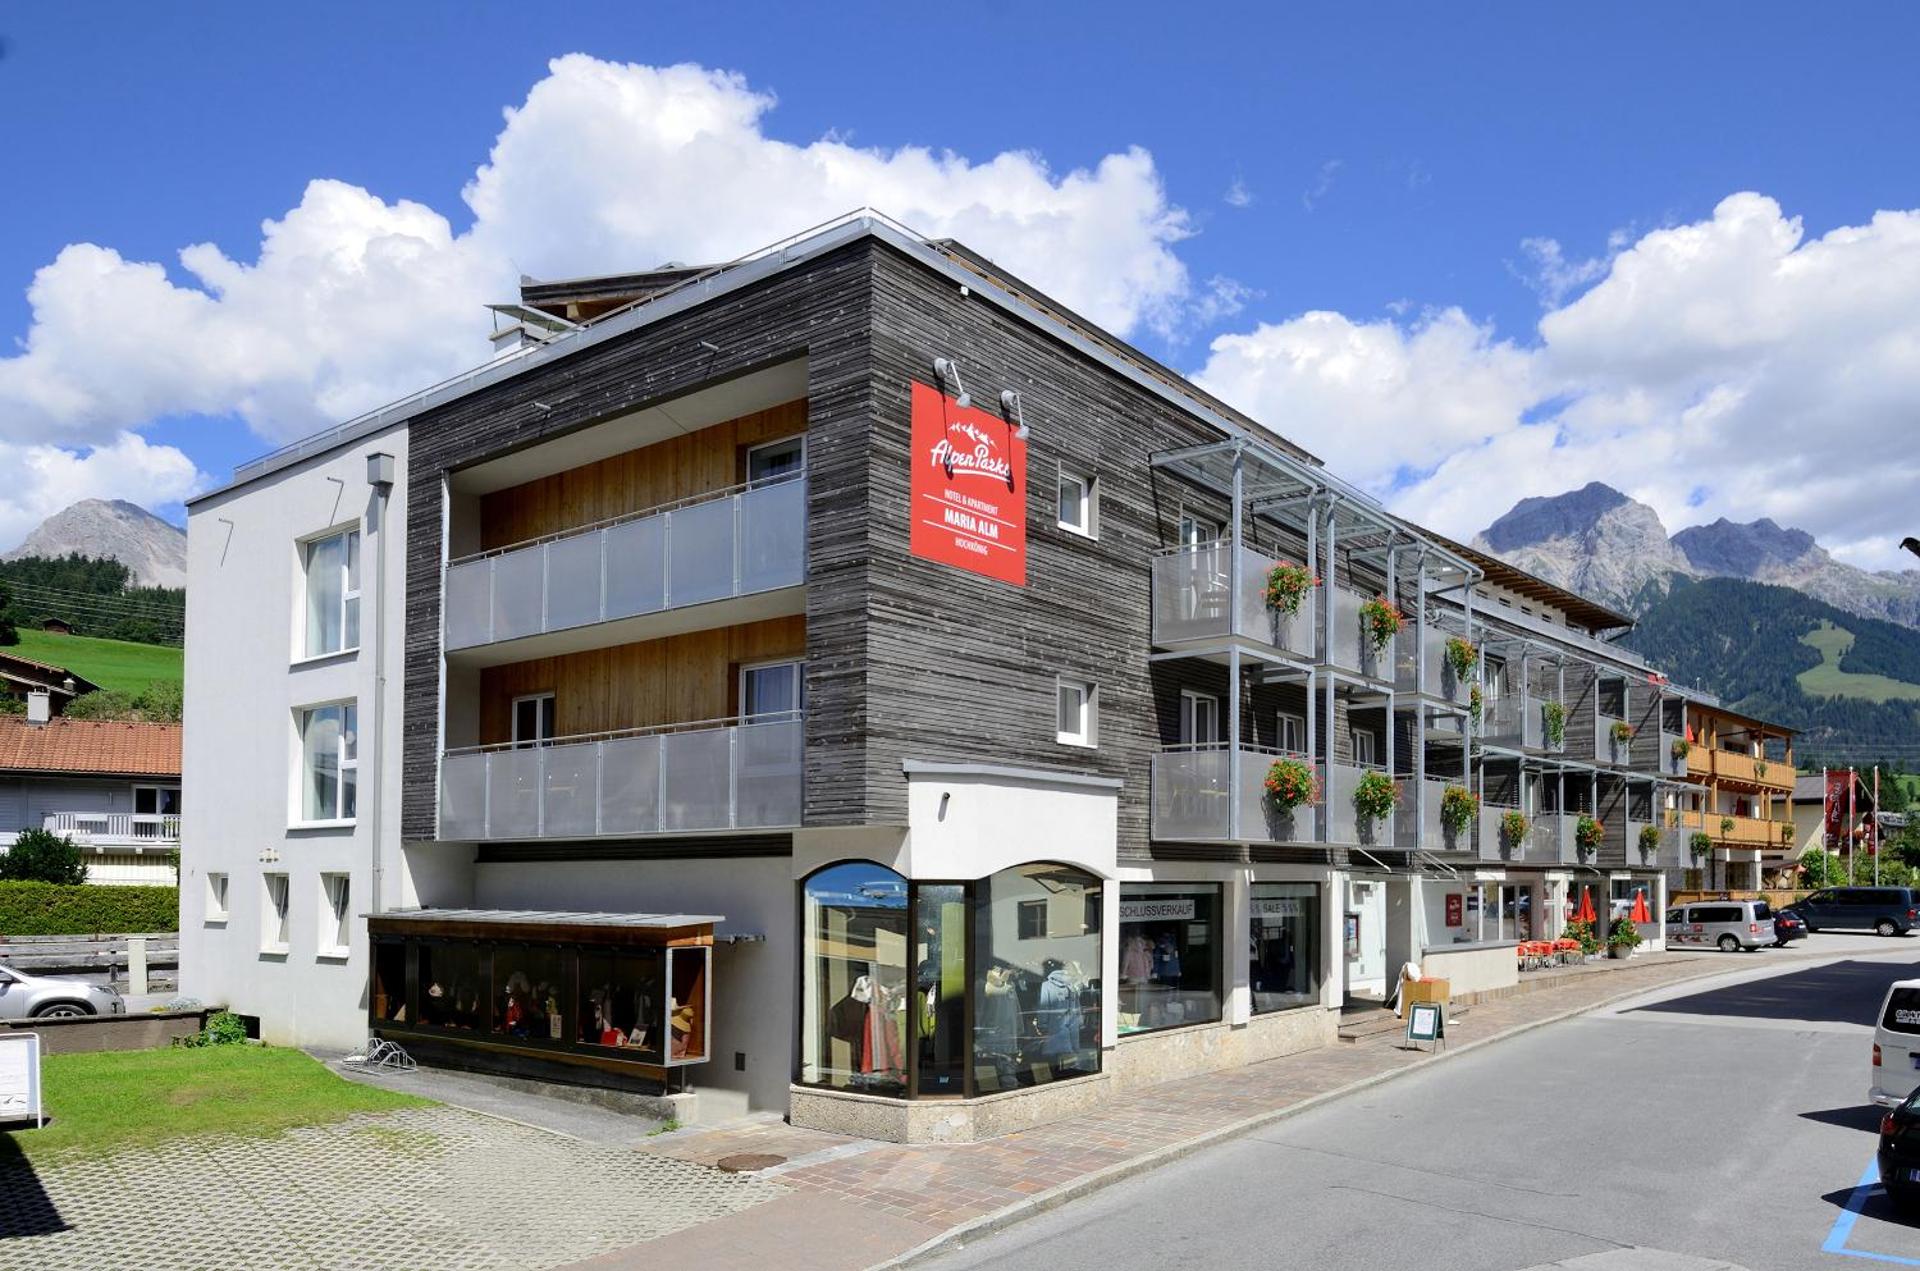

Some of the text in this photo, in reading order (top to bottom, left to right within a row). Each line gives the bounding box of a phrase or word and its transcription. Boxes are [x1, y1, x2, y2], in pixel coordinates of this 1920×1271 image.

[944, 488, 961, 504] HOTEL
[967, 496, 998, 516] APARTMENT
[944, 507, 998, 539] MARIA ALM
[955, 536, 988, 556] HOCHKÖNIG
[1262, 903, 1281, 914] SALE
